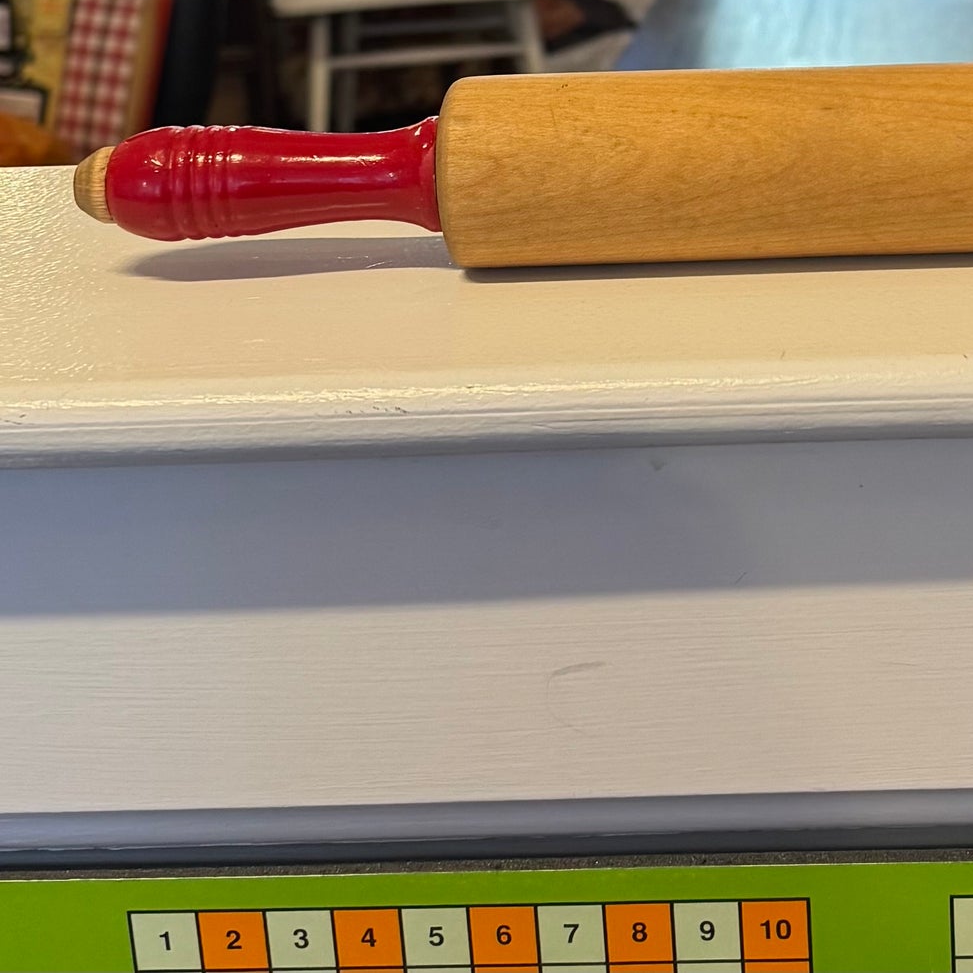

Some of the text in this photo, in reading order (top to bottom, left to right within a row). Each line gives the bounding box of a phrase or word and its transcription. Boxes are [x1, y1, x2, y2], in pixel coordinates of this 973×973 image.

[160, 920, 792, 950] 1 2 3 4 5 6 7 8 9 10
